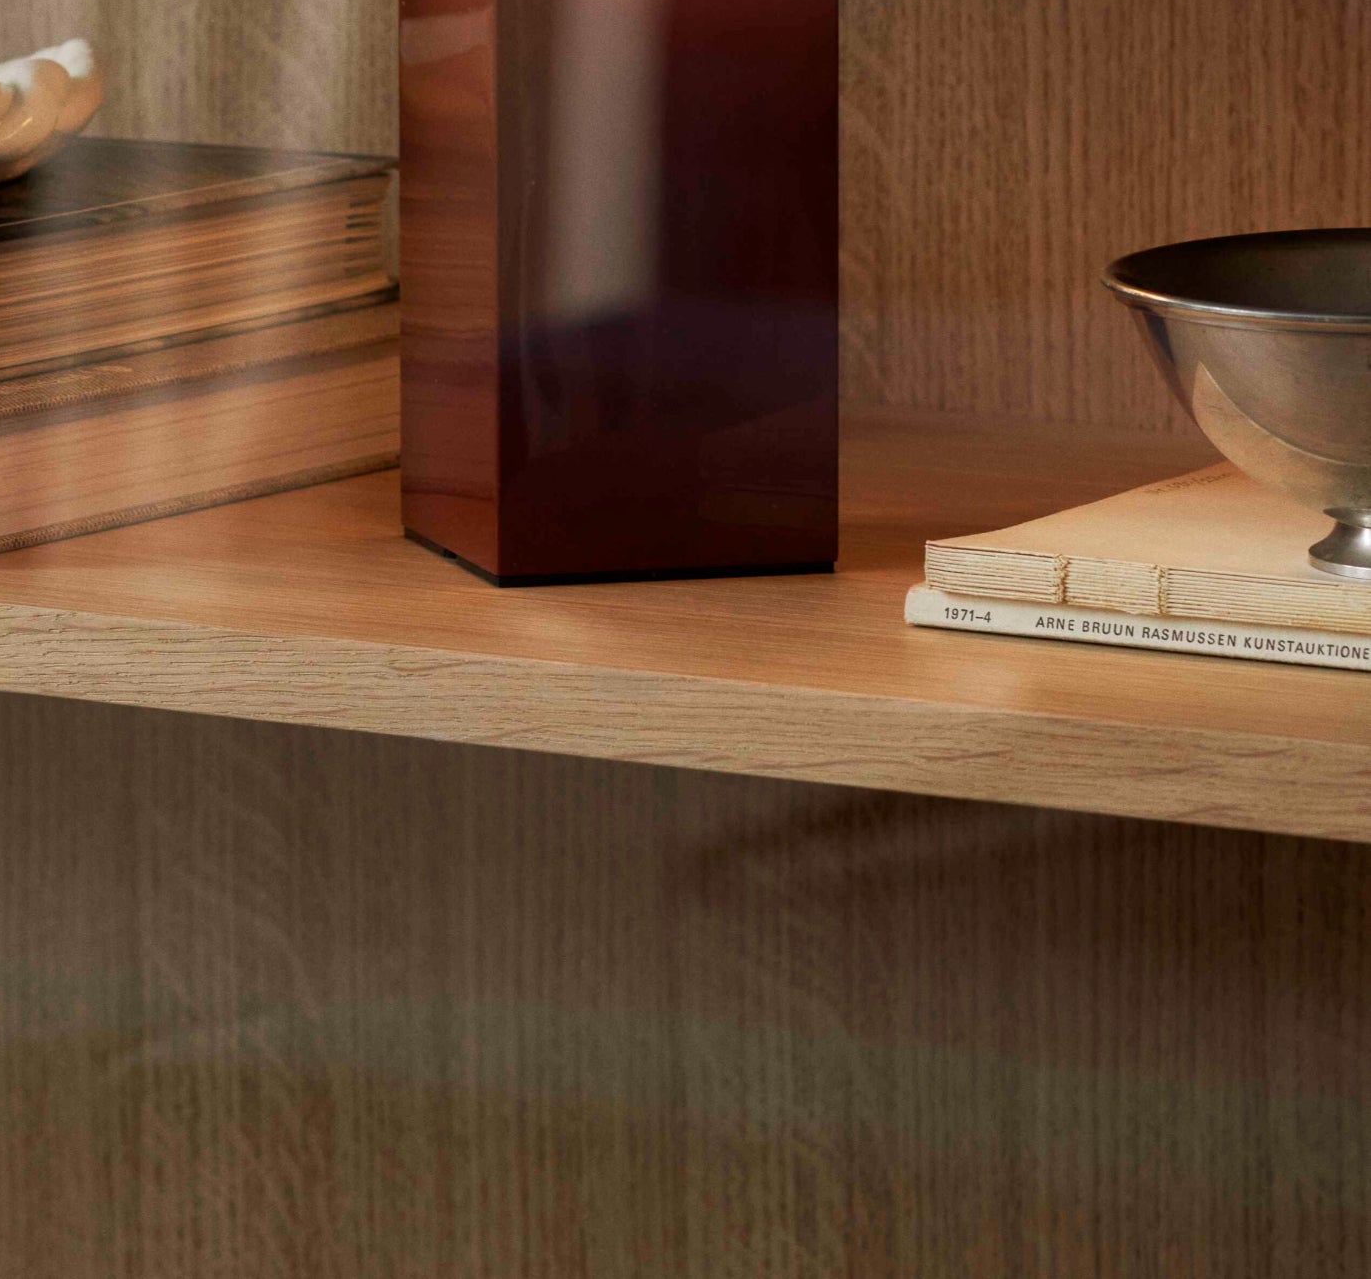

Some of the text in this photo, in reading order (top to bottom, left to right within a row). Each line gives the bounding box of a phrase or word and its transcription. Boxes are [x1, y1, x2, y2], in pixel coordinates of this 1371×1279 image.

[1035, 616, 1370, 660] ARNE BRUUN RASMUSSEN KUNSTAUKTIONE
